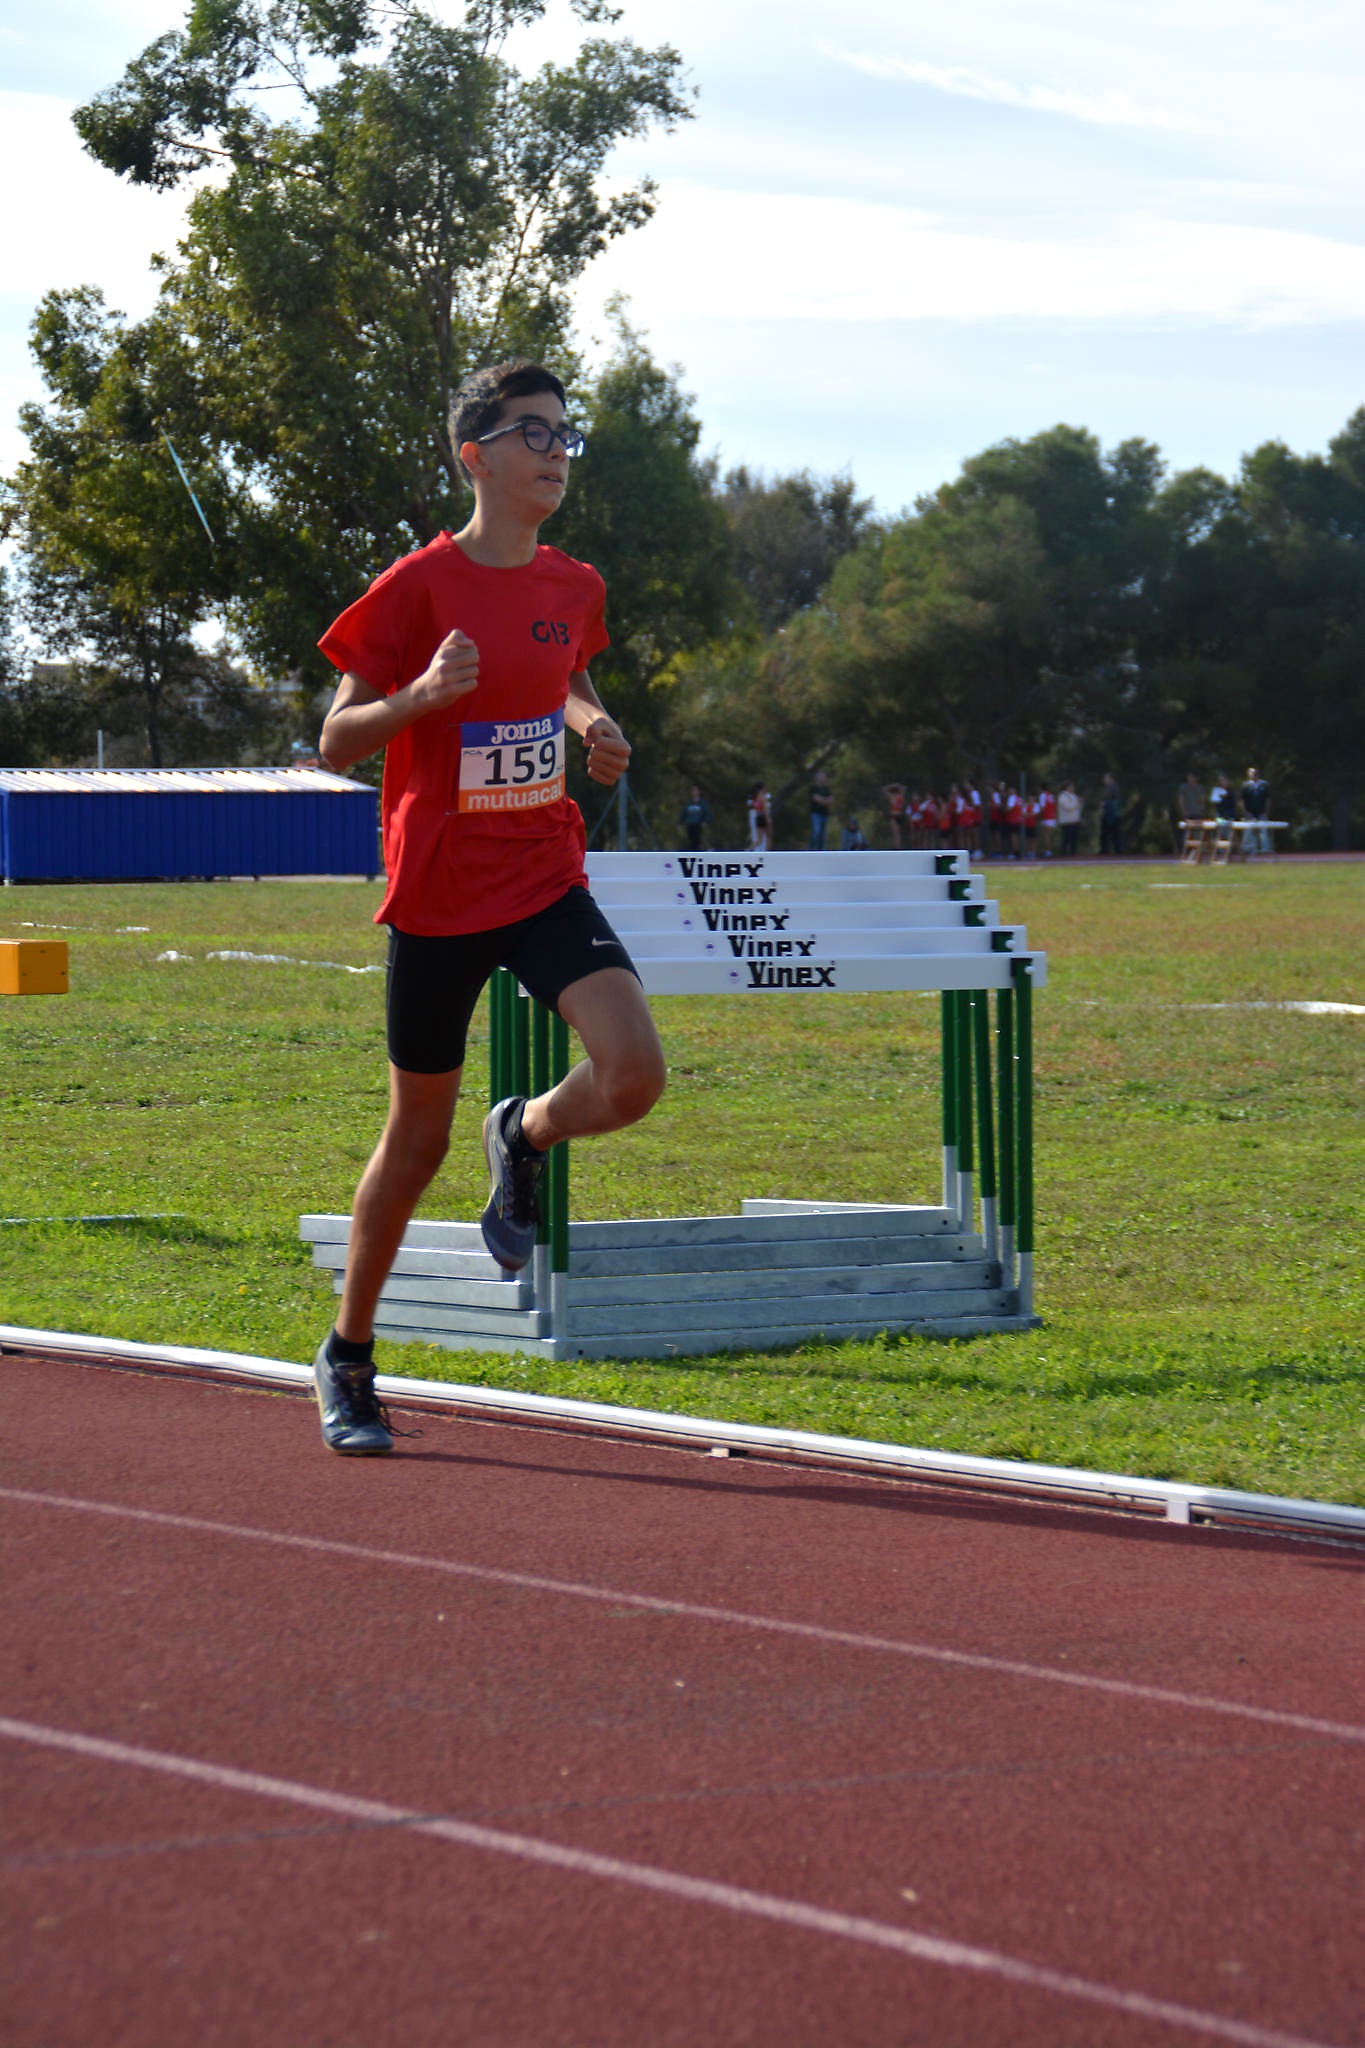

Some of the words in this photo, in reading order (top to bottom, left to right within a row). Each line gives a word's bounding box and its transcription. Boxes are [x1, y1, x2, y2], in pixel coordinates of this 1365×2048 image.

[485, 740, 556, 785] 159
[677, 857, 763, 878] Vinex
[691, 883, 777, 905] Vinex
[703, 909, 791, 931] Vinex
[728, 935, 817, 957] Vinex
[748, 961, 835, 988] Vinex
